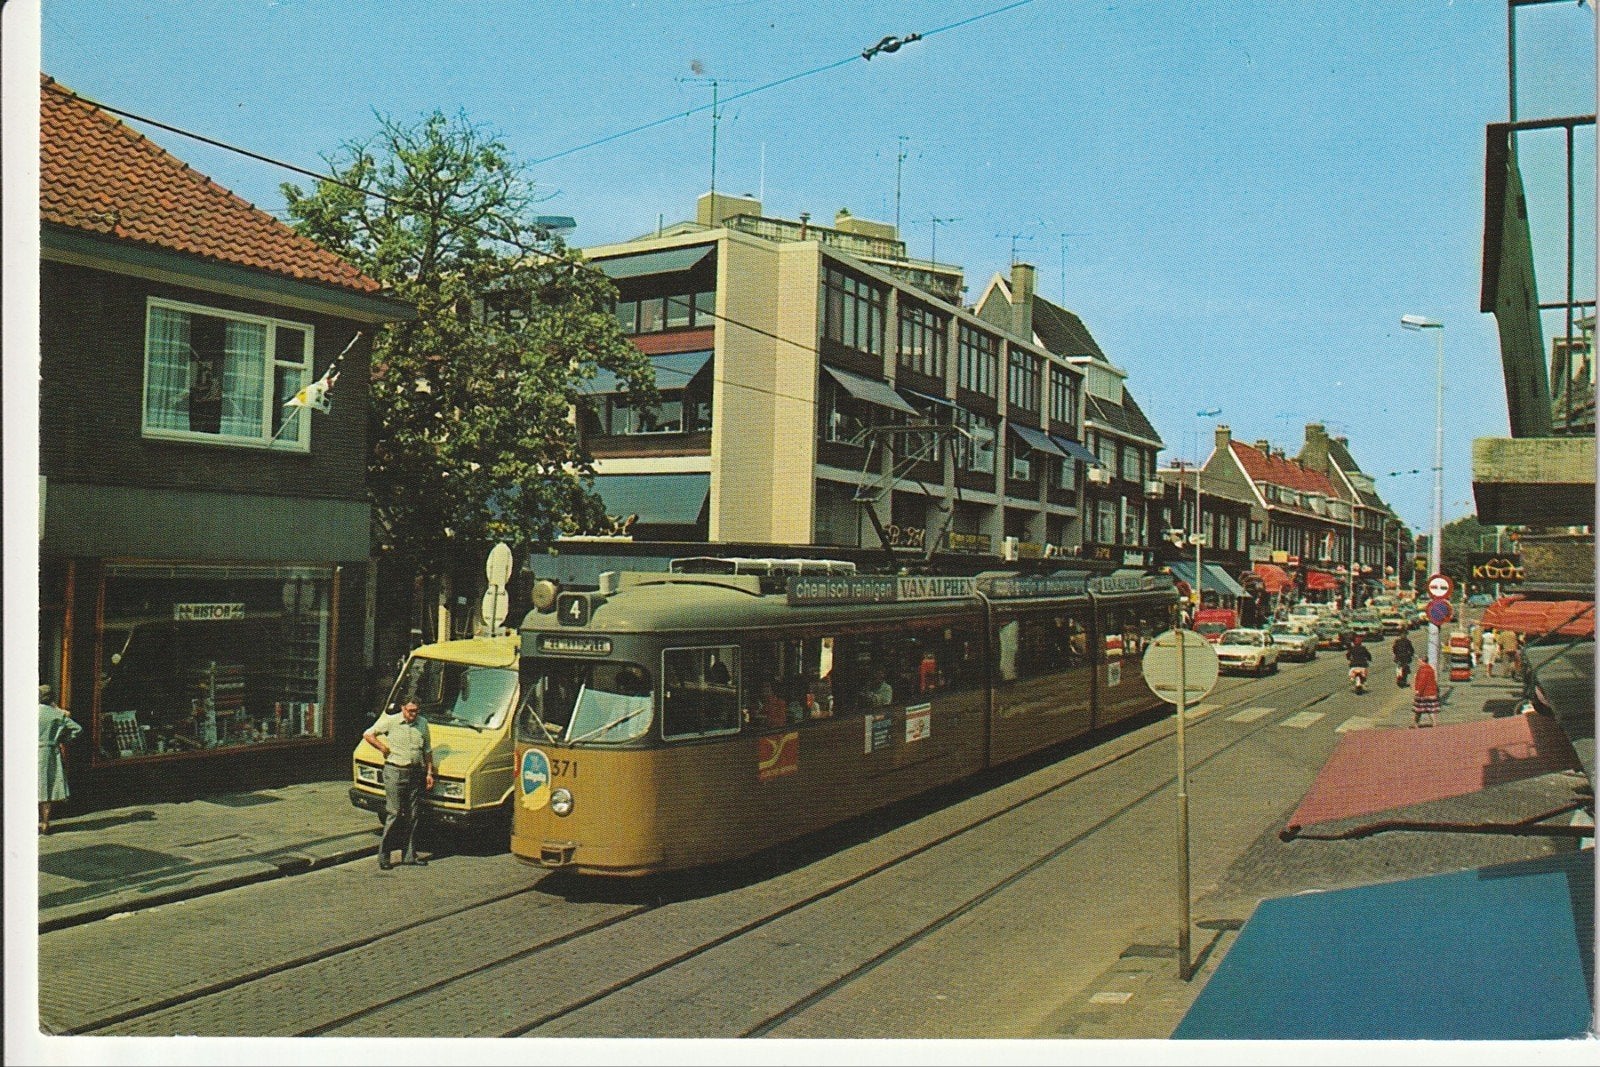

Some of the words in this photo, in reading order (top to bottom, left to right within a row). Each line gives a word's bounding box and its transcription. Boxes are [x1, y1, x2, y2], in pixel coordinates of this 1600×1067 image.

[796, 578, 849, 598] chemisch
[852, 578, 892, 601] reinigen
[901, 578, 928, 597] VAN
[929, 577, 975, 597] ALPHEN
[569, 600, 581, 619] 4
[550, 760, 578, 778] 371
